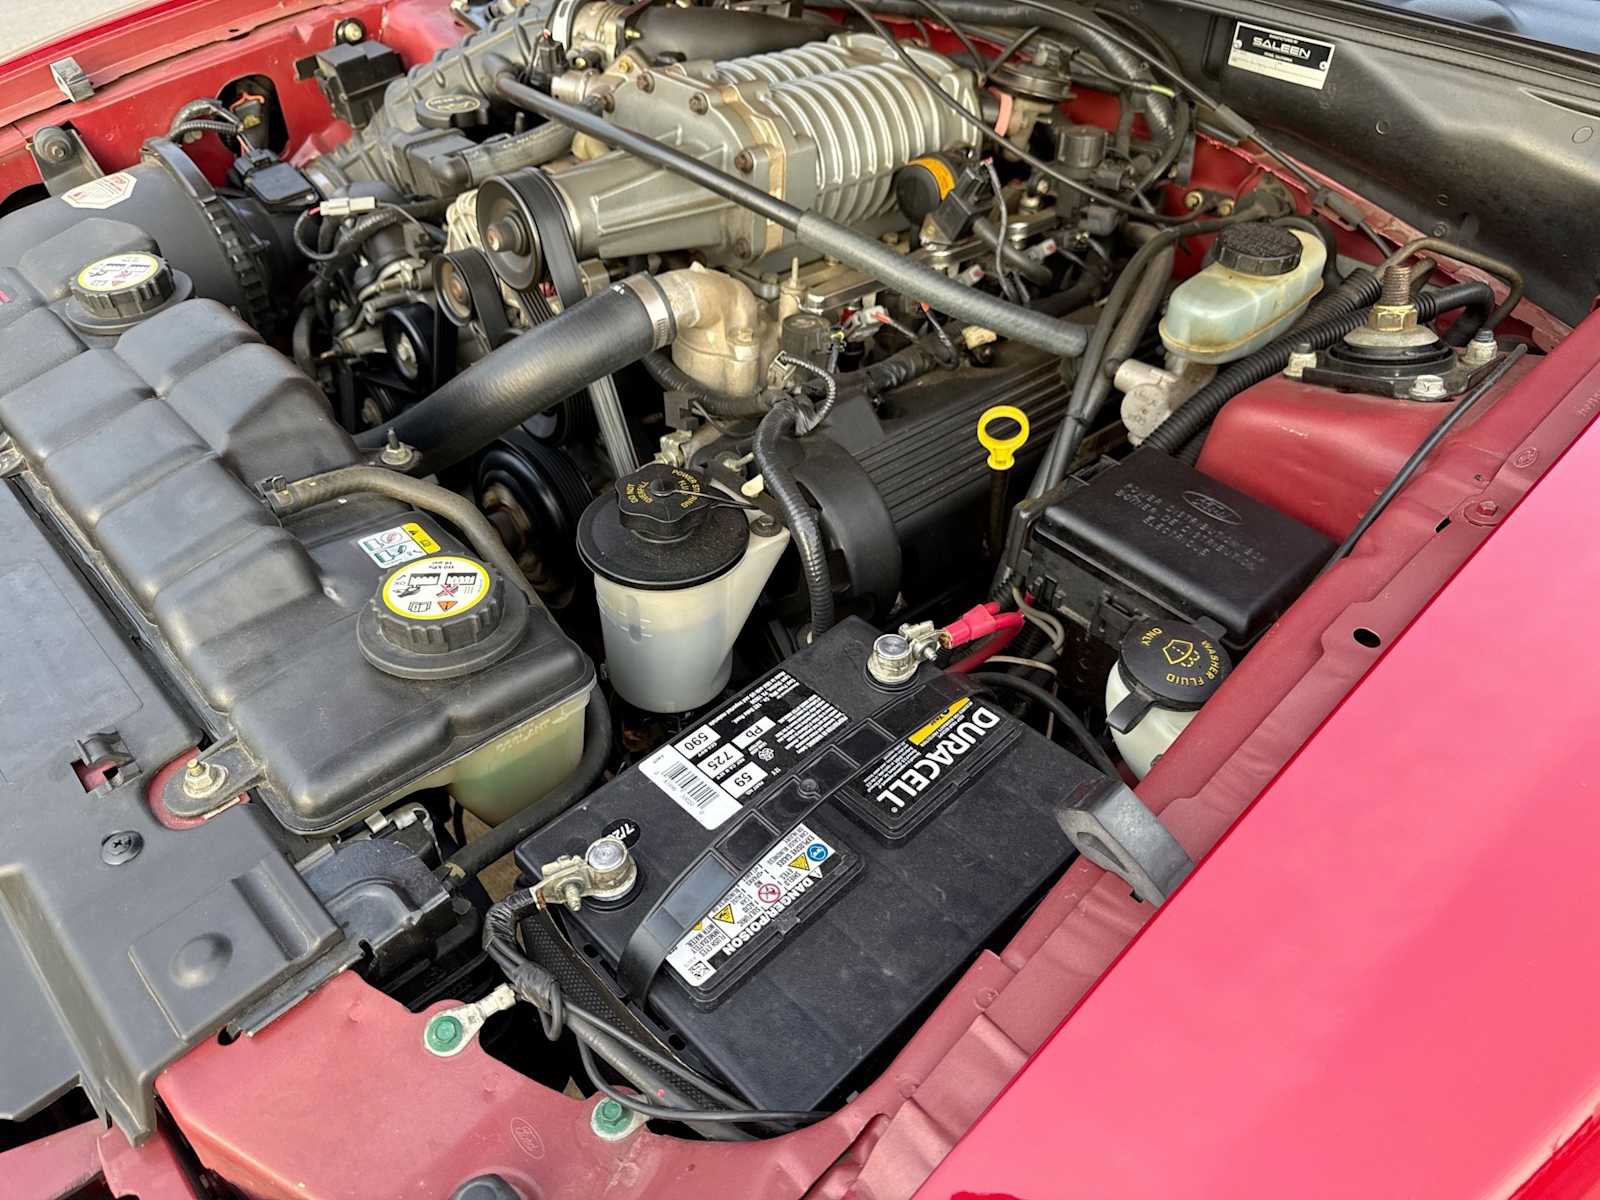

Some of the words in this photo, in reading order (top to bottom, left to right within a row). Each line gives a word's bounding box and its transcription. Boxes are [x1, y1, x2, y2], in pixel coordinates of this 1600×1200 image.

[1252, 36, 1311, 60] SALEEN
[1141, 627, 1163, 647] ONLY
[1201, 640, 1220, 680] WASHER
[1166, 673, 1205, 686] FLUID
[745, 725, 763, 739] Pb
[684, 732, 709, 751] 590
[707, 750, 734, 771] 725
[876, 706, 1000, 808] DURACELL
[734, 771, 753, 788] 59
[612, 823, 635, 840] 7/2
[787, 836, 801, 848] CAUSE
[789, 833, 814, 856] EXPLOSIVE
[775, 853, 792, 867] GASES
[778, 867, 793, 880] EYES
[783, 870, 801, 886] SHIELD
[741, 900, 755, 913] ACID
[723, 876, 813, 956] DANGER/POISON
[736, 905, 760, 927] SULFURIC
[690, 927, 720, 954] IMMEDIATELY
[709, 933, 725, 947] FLUSH
[698, 944, 712, 957] EYES
